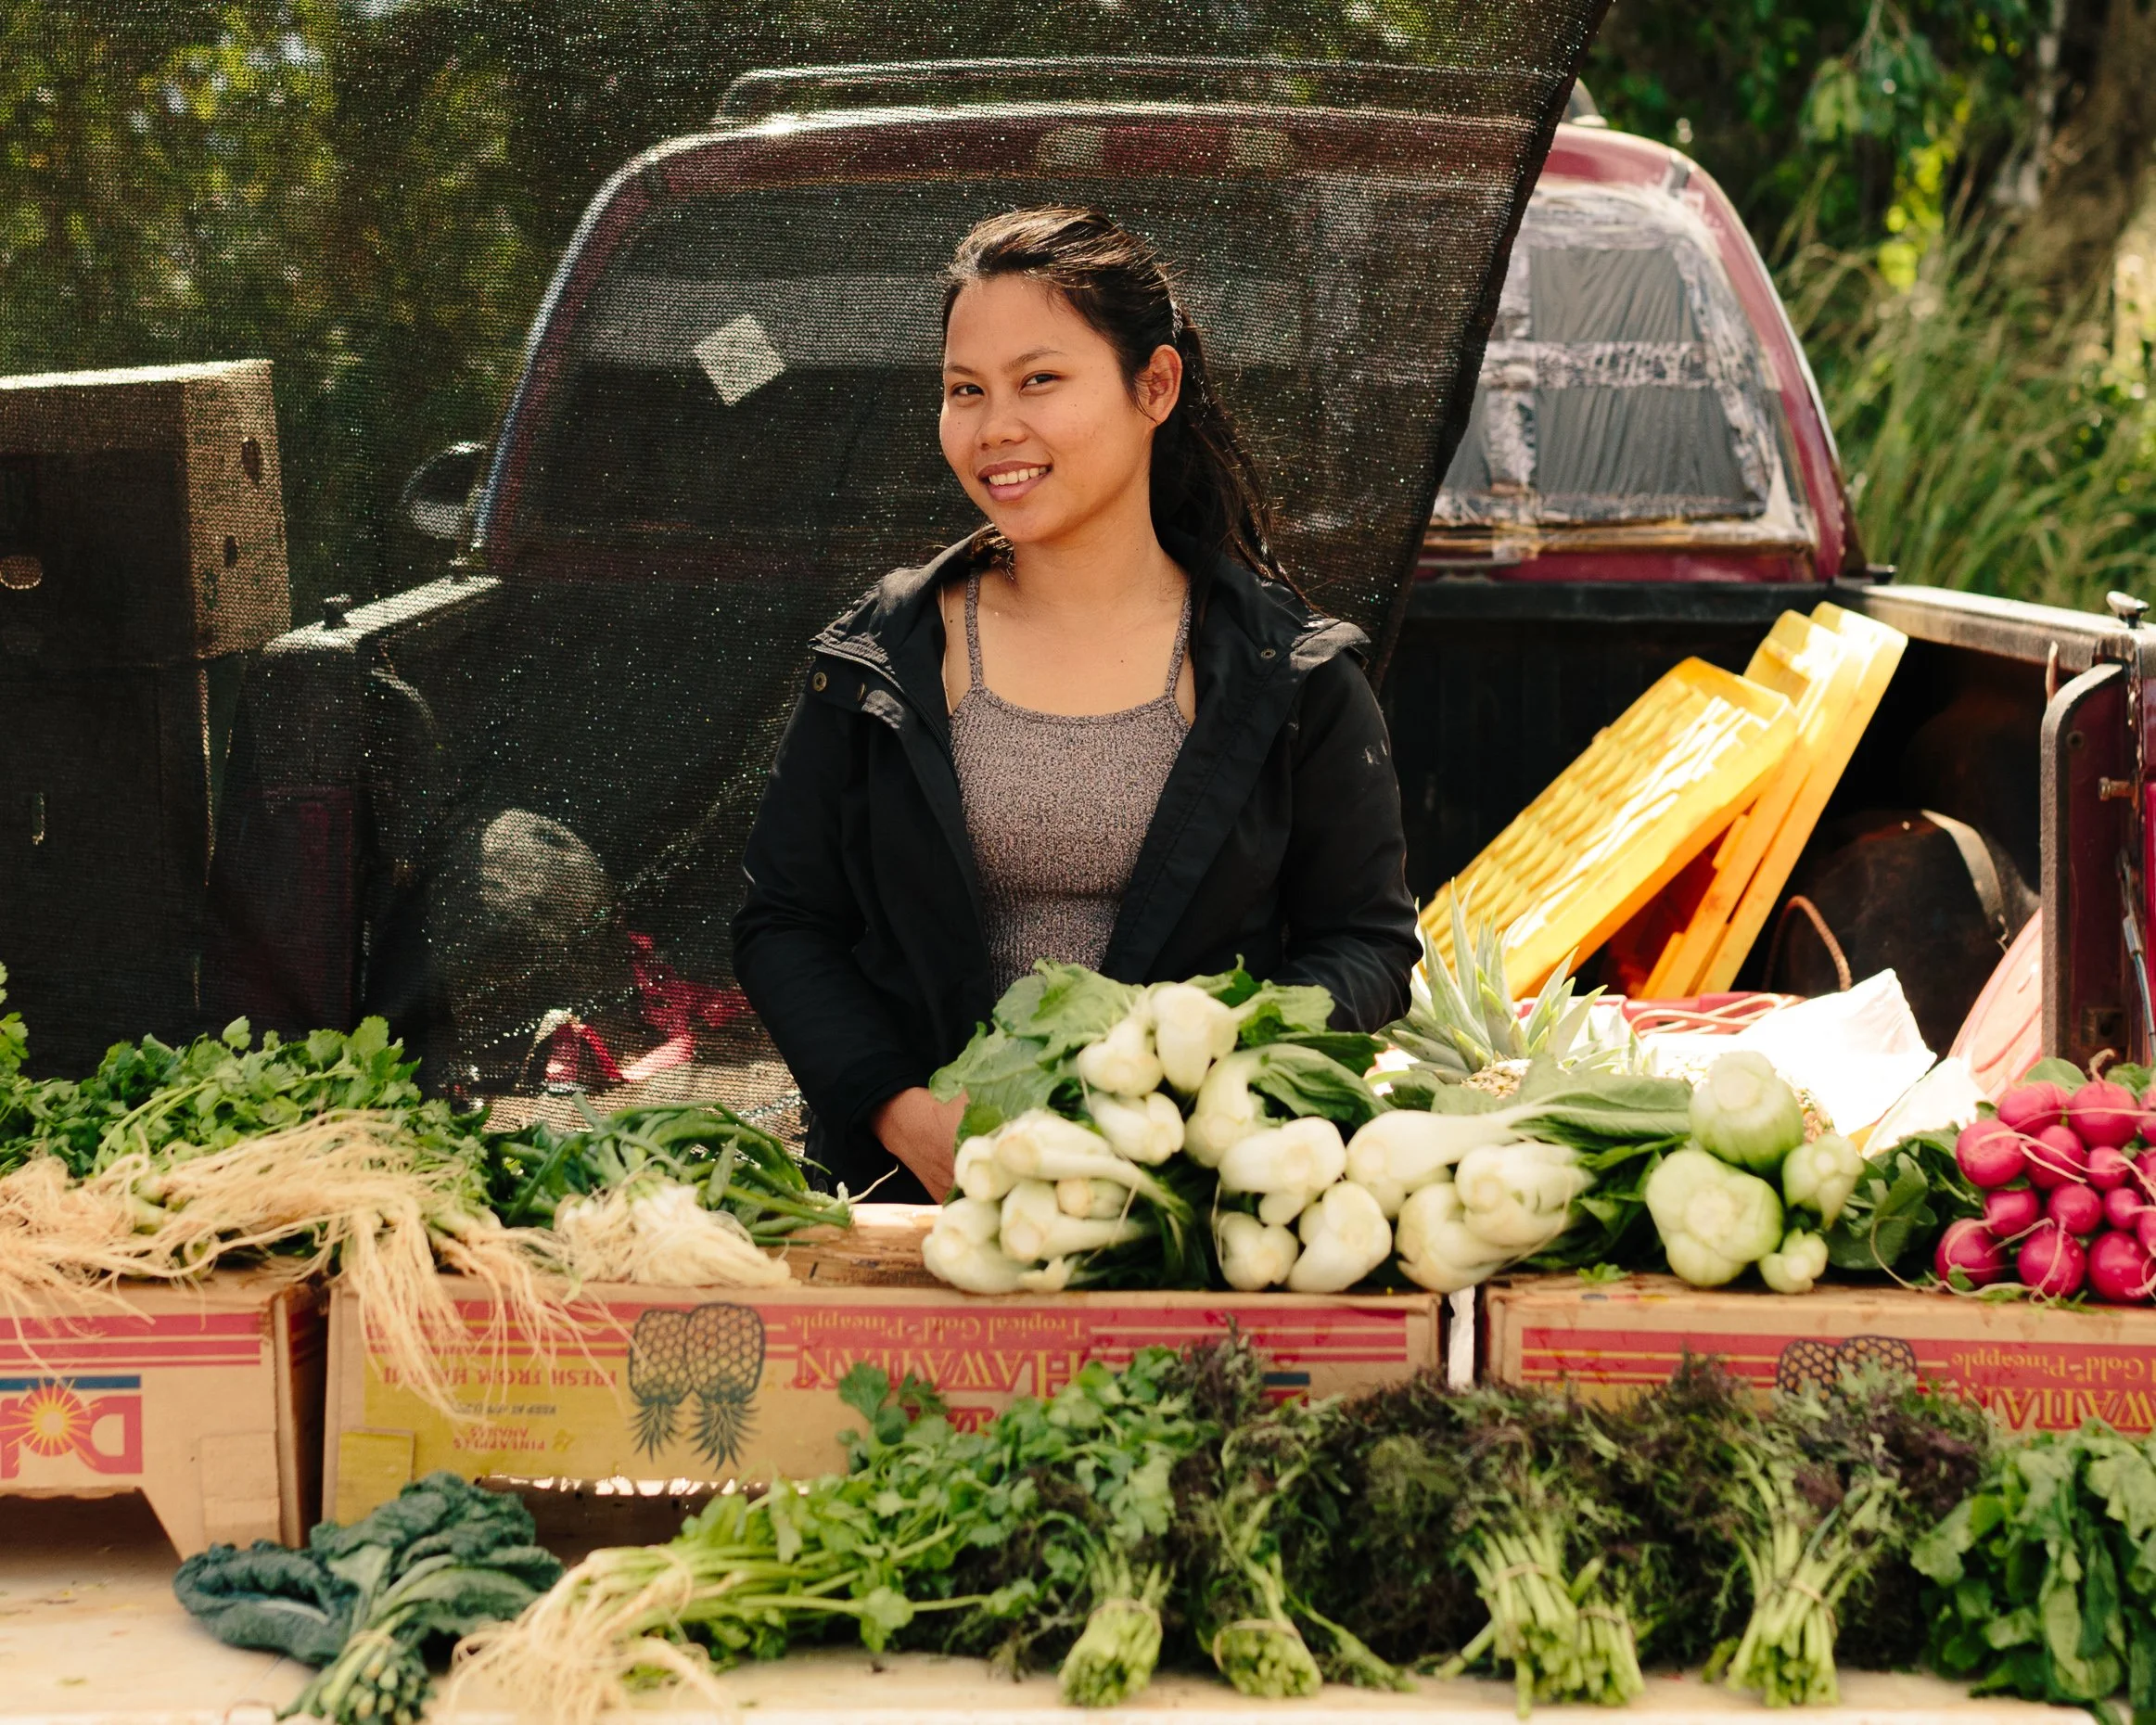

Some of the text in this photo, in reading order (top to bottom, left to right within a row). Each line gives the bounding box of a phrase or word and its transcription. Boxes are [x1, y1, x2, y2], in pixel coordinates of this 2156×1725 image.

[988, 1312, 1084, 1344] Tropical
[477, 1367, 542, 1387] FROM
[551, 1368, 617, 1388] FRESH
